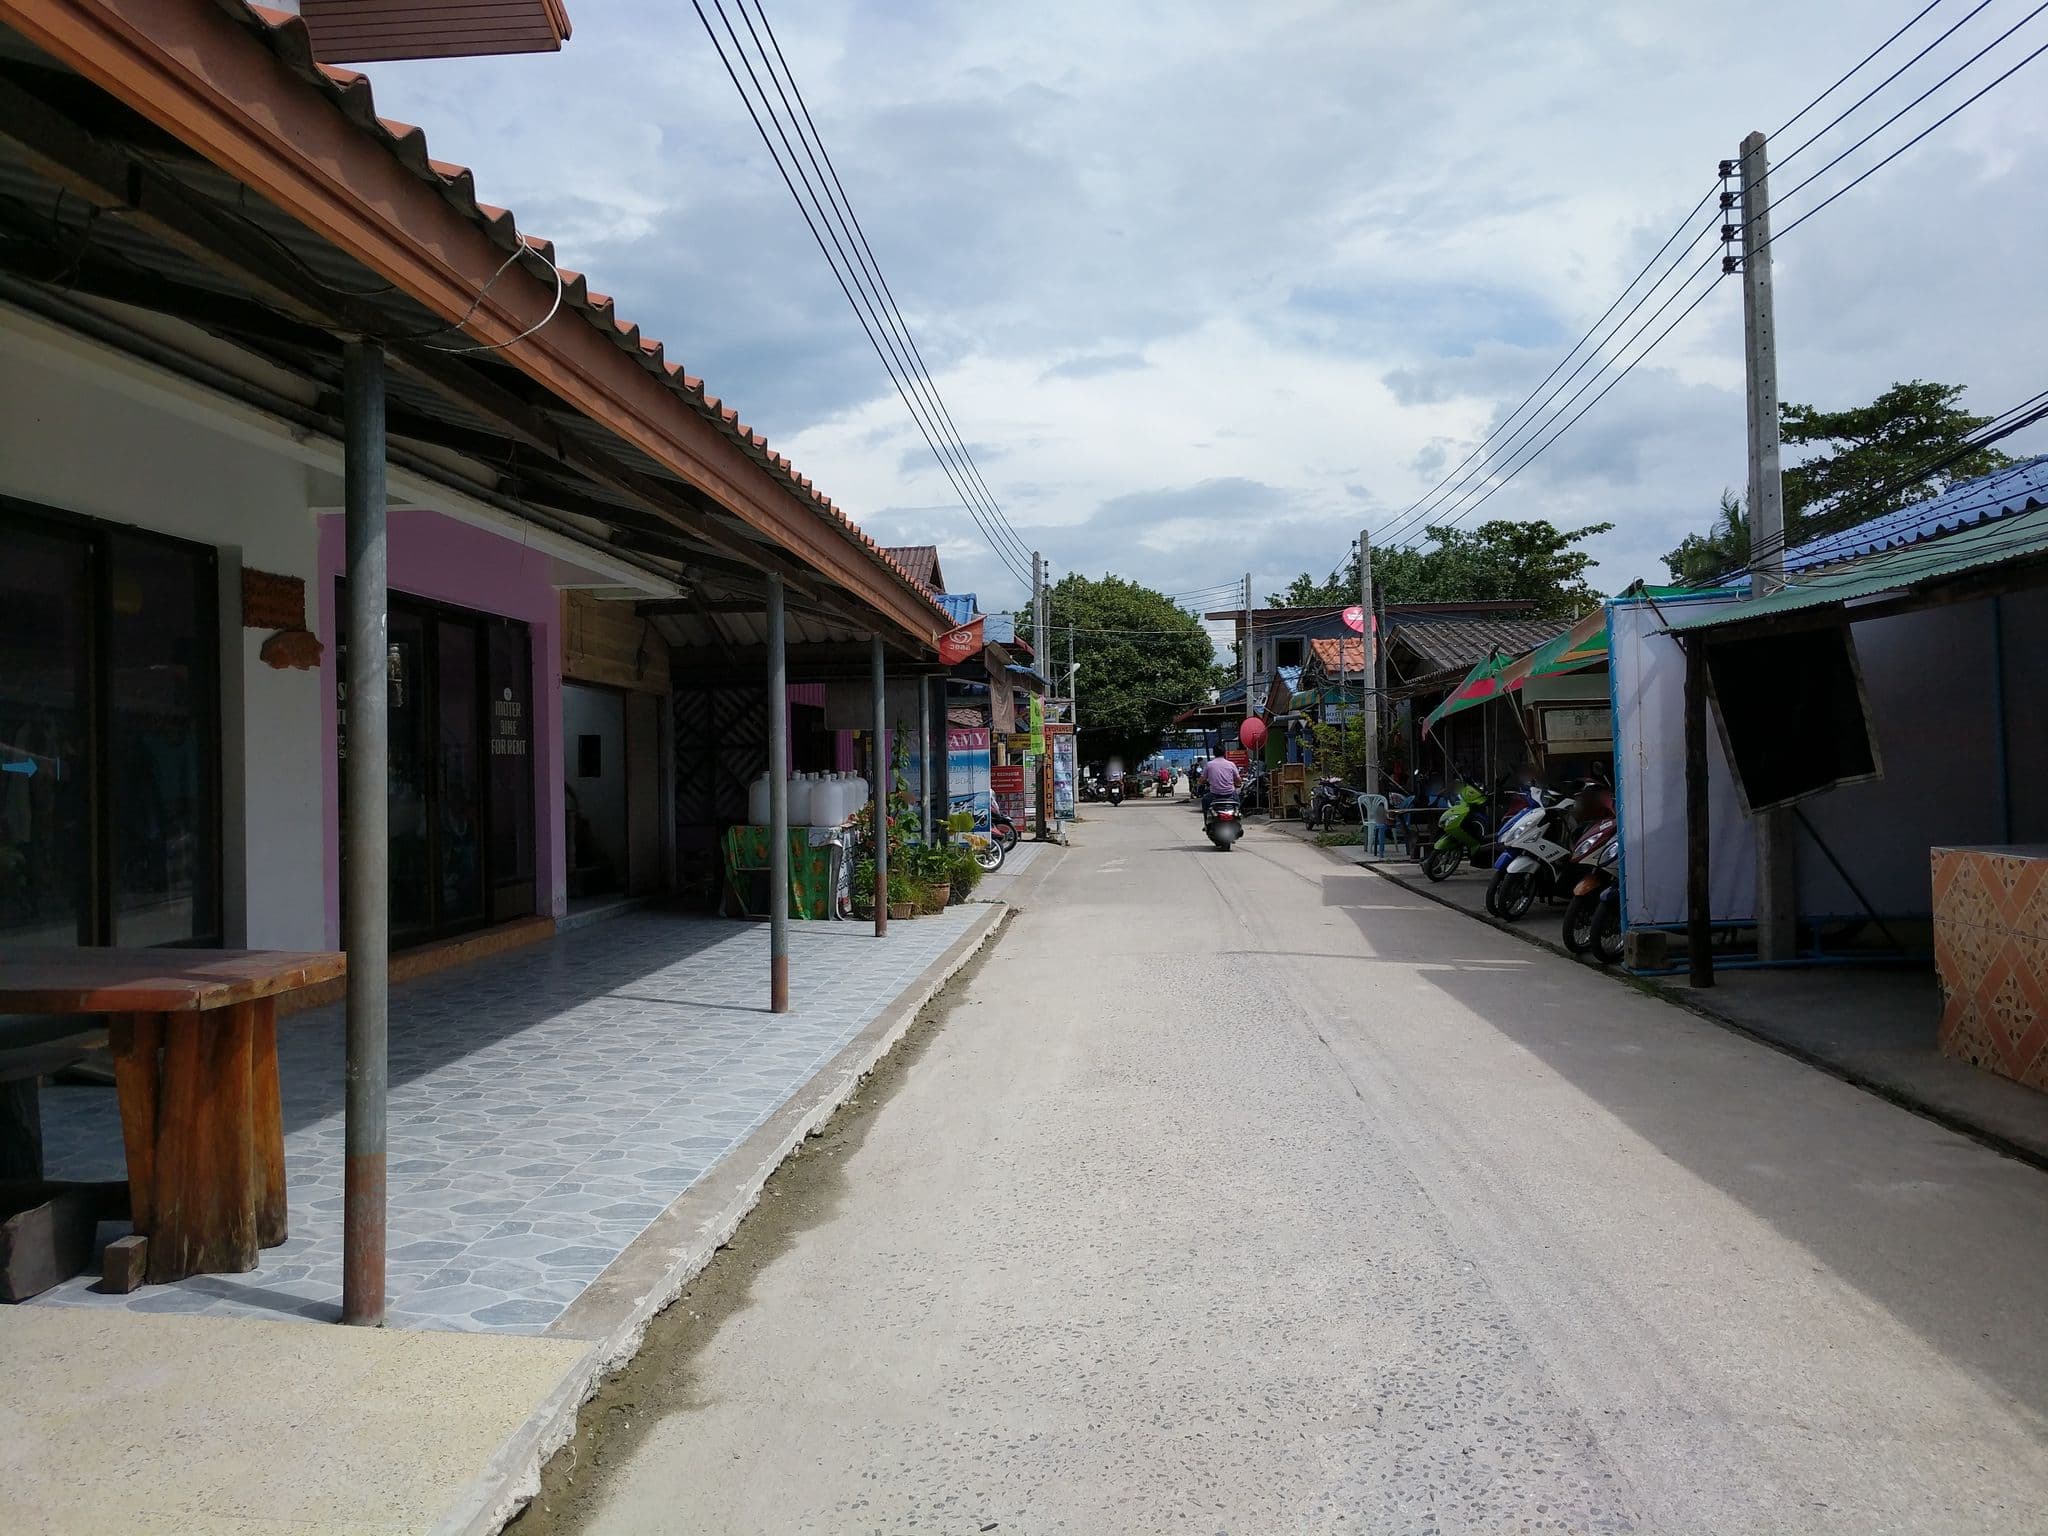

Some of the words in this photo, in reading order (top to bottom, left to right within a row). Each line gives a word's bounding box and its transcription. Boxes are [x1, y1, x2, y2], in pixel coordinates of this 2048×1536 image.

[495, 701, 521, 717] MOTER
[491, 739, 506, 755] FOR
[507, 739, 526, 755] RENT
